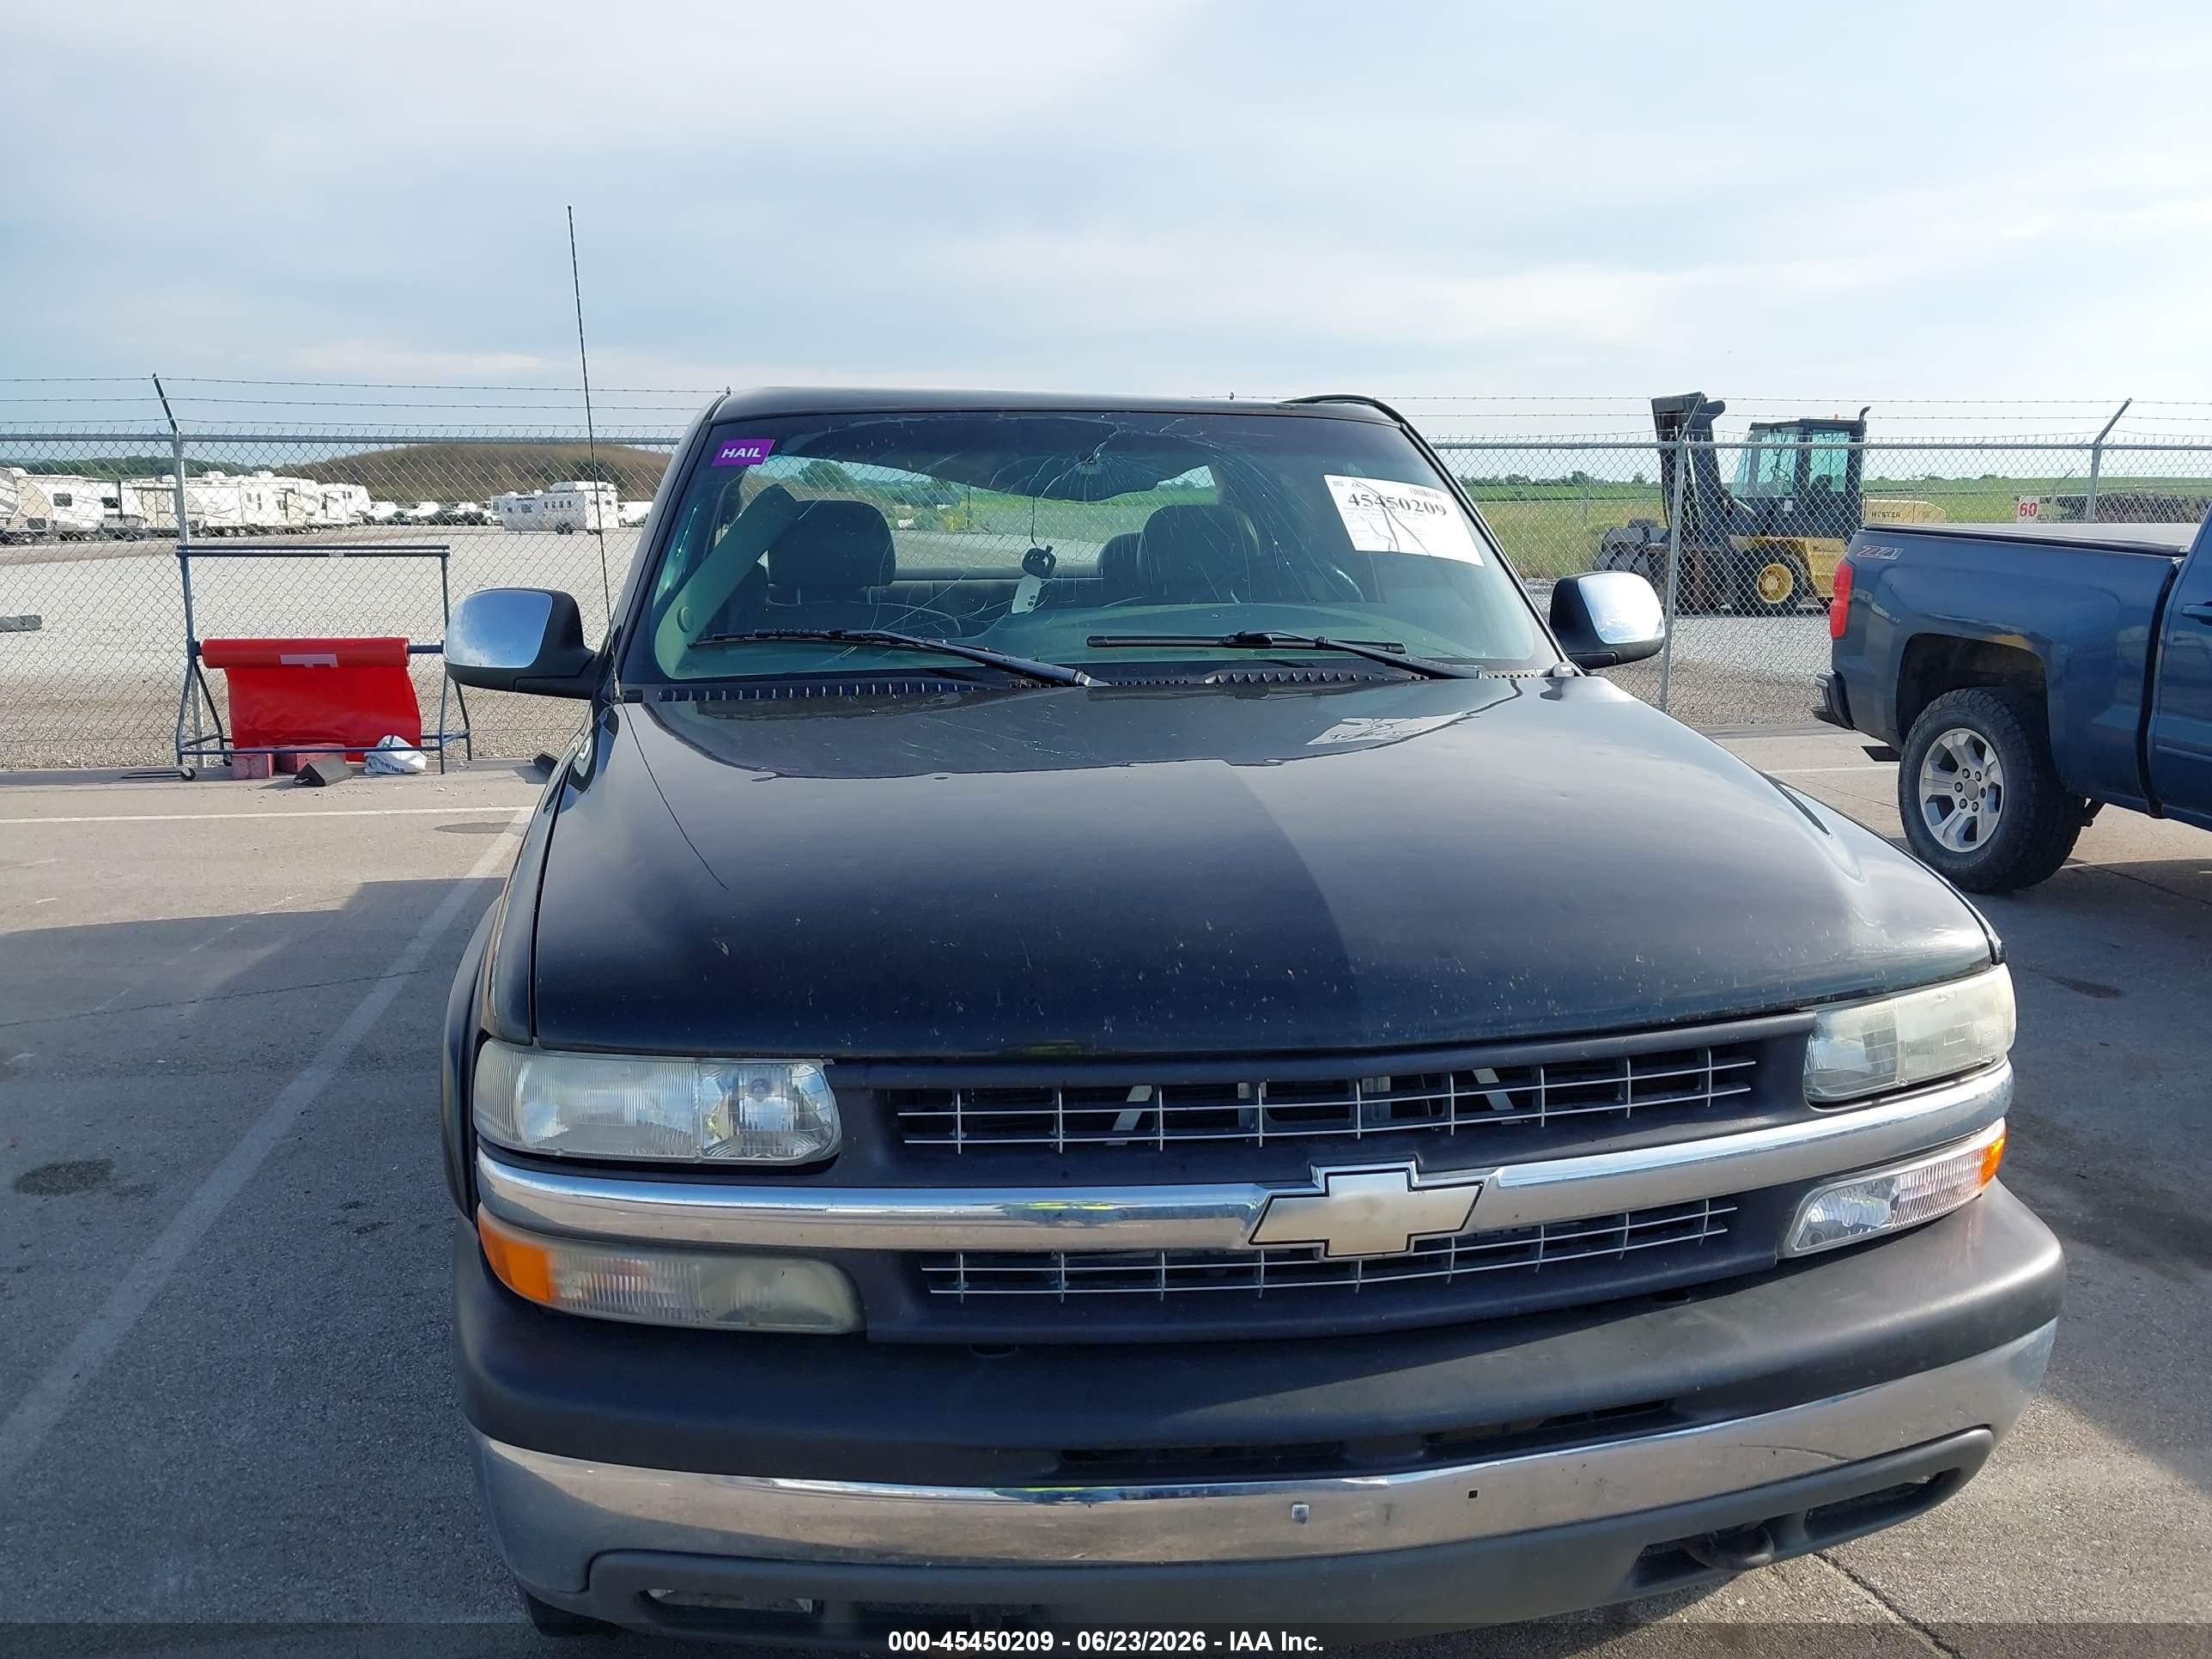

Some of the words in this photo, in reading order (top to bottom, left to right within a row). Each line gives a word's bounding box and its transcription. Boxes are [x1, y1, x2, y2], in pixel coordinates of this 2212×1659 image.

[721, 447, 762, 459] HAIL
[1348, 494, 1447, 515] 45450209
[2020, 502, 2038, 516] 60
[1856, 544, 1904, 560] Z71
